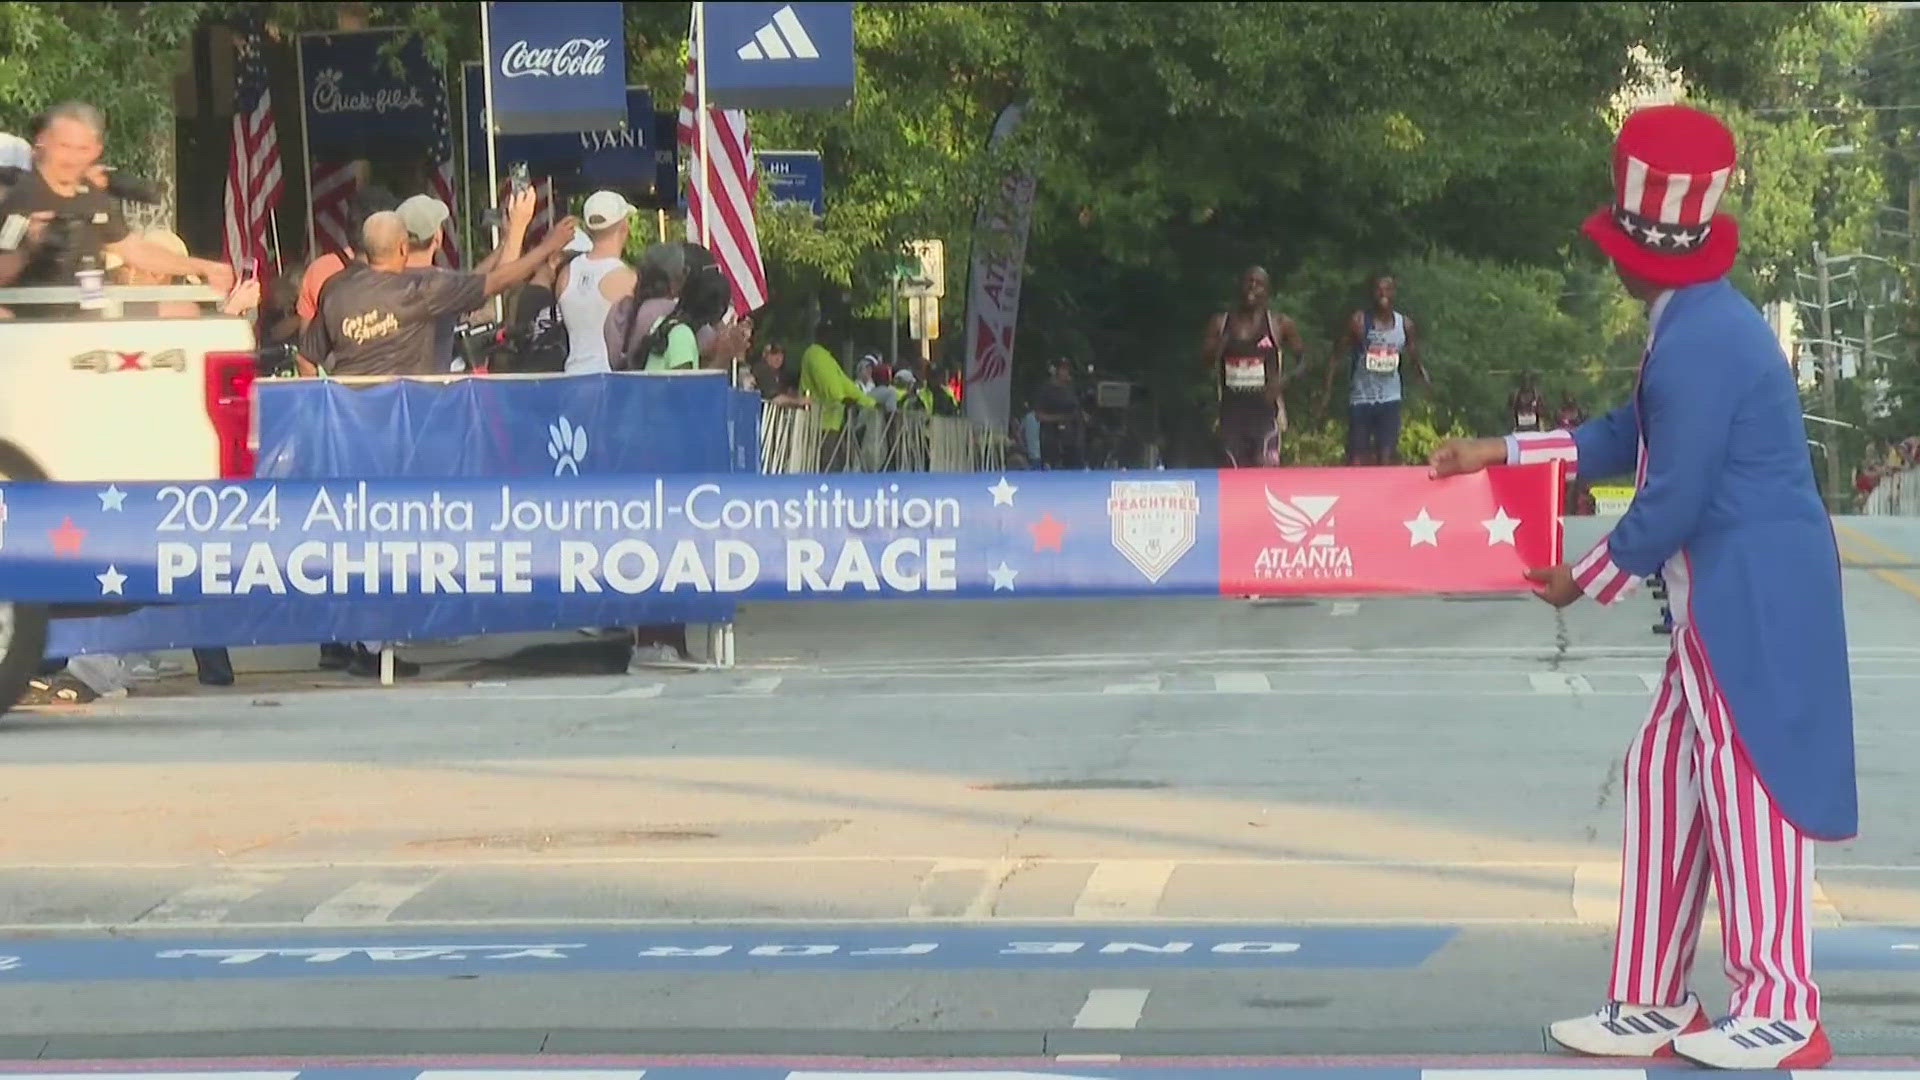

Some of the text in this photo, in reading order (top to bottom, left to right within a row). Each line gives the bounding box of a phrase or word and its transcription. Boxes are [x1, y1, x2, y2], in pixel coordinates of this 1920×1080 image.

[502, 38, 611, 78] Coca-Cola
[155, 478, 960, 532] 2024 Atlanta Journal-Constitution
[1110, 497, 1197, 511] PEACHTREE
[156, 538, 957, 595] PEACHTREE ROAD RACE
[1254, 546, 1353, 569] ATLANTA
[1254, 567, 1353, 579] TRACK CLUB
[999, 941, 1301, 955] ONE
